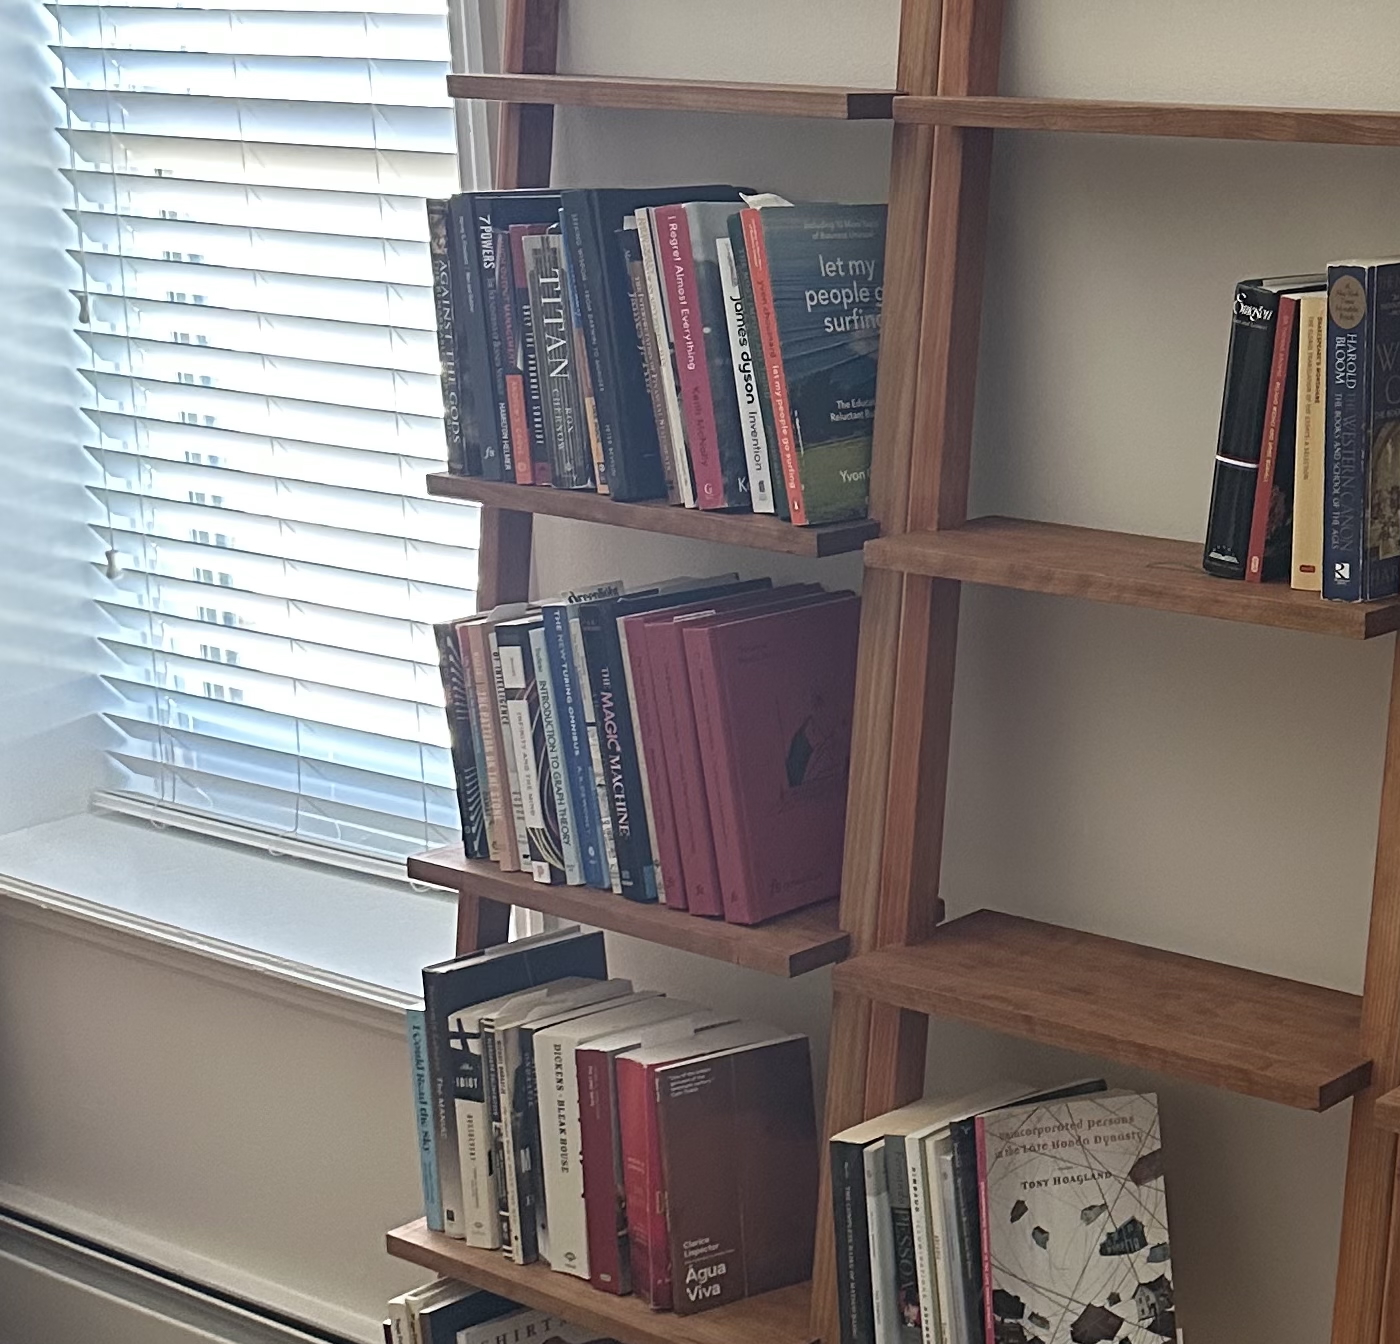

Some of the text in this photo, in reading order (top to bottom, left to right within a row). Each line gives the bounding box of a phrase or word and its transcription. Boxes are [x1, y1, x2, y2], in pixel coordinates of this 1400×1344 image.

[478, 214, 495, 269] 7 POWERS
[668, 222, 681, 262] Regret
[820, 254, 875, 281] let my
[437, 260, 452, 340] AGAINST
[578, 249, 597, 346] WISDOM FROM DARWIN
[673, 265, 688, 305] Almost
[804, 280, 870, 312] people
[537, 268, 569, 381] TITAN
[679, 308, 697, 370] Everything
[447, 351, 455, 382] THE
[521, 305, 545, 445] ONLY THE PARANOID SURVIVE
[730, 296, 764, 472] james dyson Invention
[1334, 336, 1347, 385] BLOOM
[1345, 333, 1358, 390] HAROLD
[450, 392, 461, 443] GODS
[551, 388, 574, 451] RON CHERNOW
[651, 373, 663, 418] FINANCIAL
[830, 410, 863, 422] Reluctant
[836, 400, 850, 410] The
[499, 402, 511, 470] HAMILTON HELMER
[695, 419, 710, 468] McNally
[772, 364, 797, 490] let my people go surfing
[839, 468, 866, 483] Yvon
[1331, 393, 1343, 550] THE BOOKS AND SCHOOL OF THE AGES
[1339, 414, 1356, 553] WESTERN CANON
[492, 652, 509, 726] OF INTELLIGENCE
[553, 610, 580, 756] THE NEW TURING OMNIBUS
[477, 691, 503, 821] THE PATTERN ON THE STONE
[516, 712, 536, 817] INFINITY AND THE MIND
[538, 680, 572, 847] INTRODUCTION TO GRAPH THEORY
[600, 667, 631, 838] THE MAGIC MACHINE
[413, 1031, 432, 1154] Could Read the Sky
[455, 1077, 478, 1089] IDIOT
[553, 1043, 569, 1174] DICKENS BLEAK HOUSE
[1022, 1131, 1143, 1153] Late Honda Dynasty
[911, 1167, 920, 1213] RIMBAUD
[1021, 1171, 1112, 1190] TONY HOAGLAND
[683, 1235, 710, 1249] Clarice
[683, 1243, 720, 1258] Lispector
[893, 1209, 915, 1290] PESSOA
[915, 1220, 927, 1299] ILLUMINATIONS
[685, 1262, 727, 1284] Água
[686, 1282, 721, 1302] Viva
